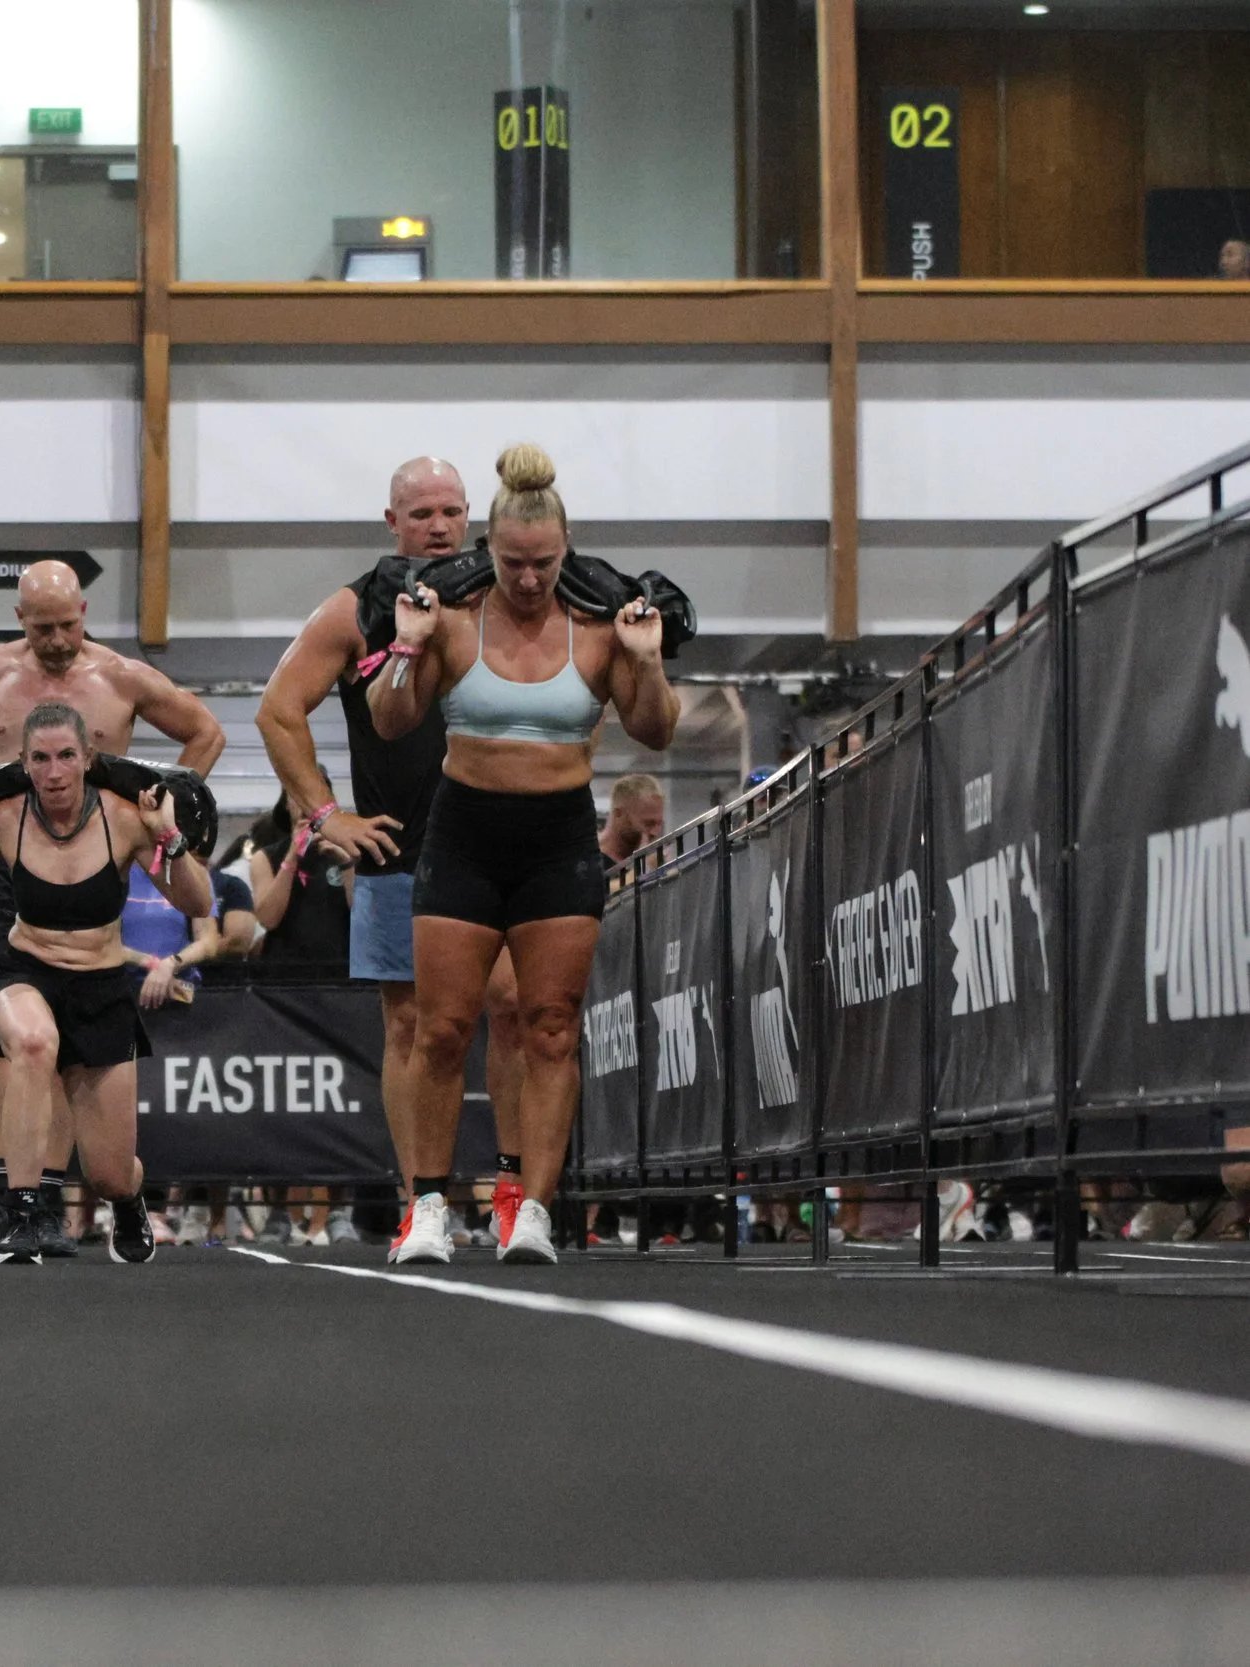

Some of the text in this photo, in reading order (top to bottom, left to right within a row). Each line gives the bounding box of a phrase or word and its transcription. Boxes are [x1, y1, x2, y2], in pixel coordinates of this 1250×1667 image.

[37, 111, 72, 129] EXIT
[498, 106, 542, 150] 01
[889, 103, 952, 148] 02
[164, 1055, 361, 1114] FASTER.
